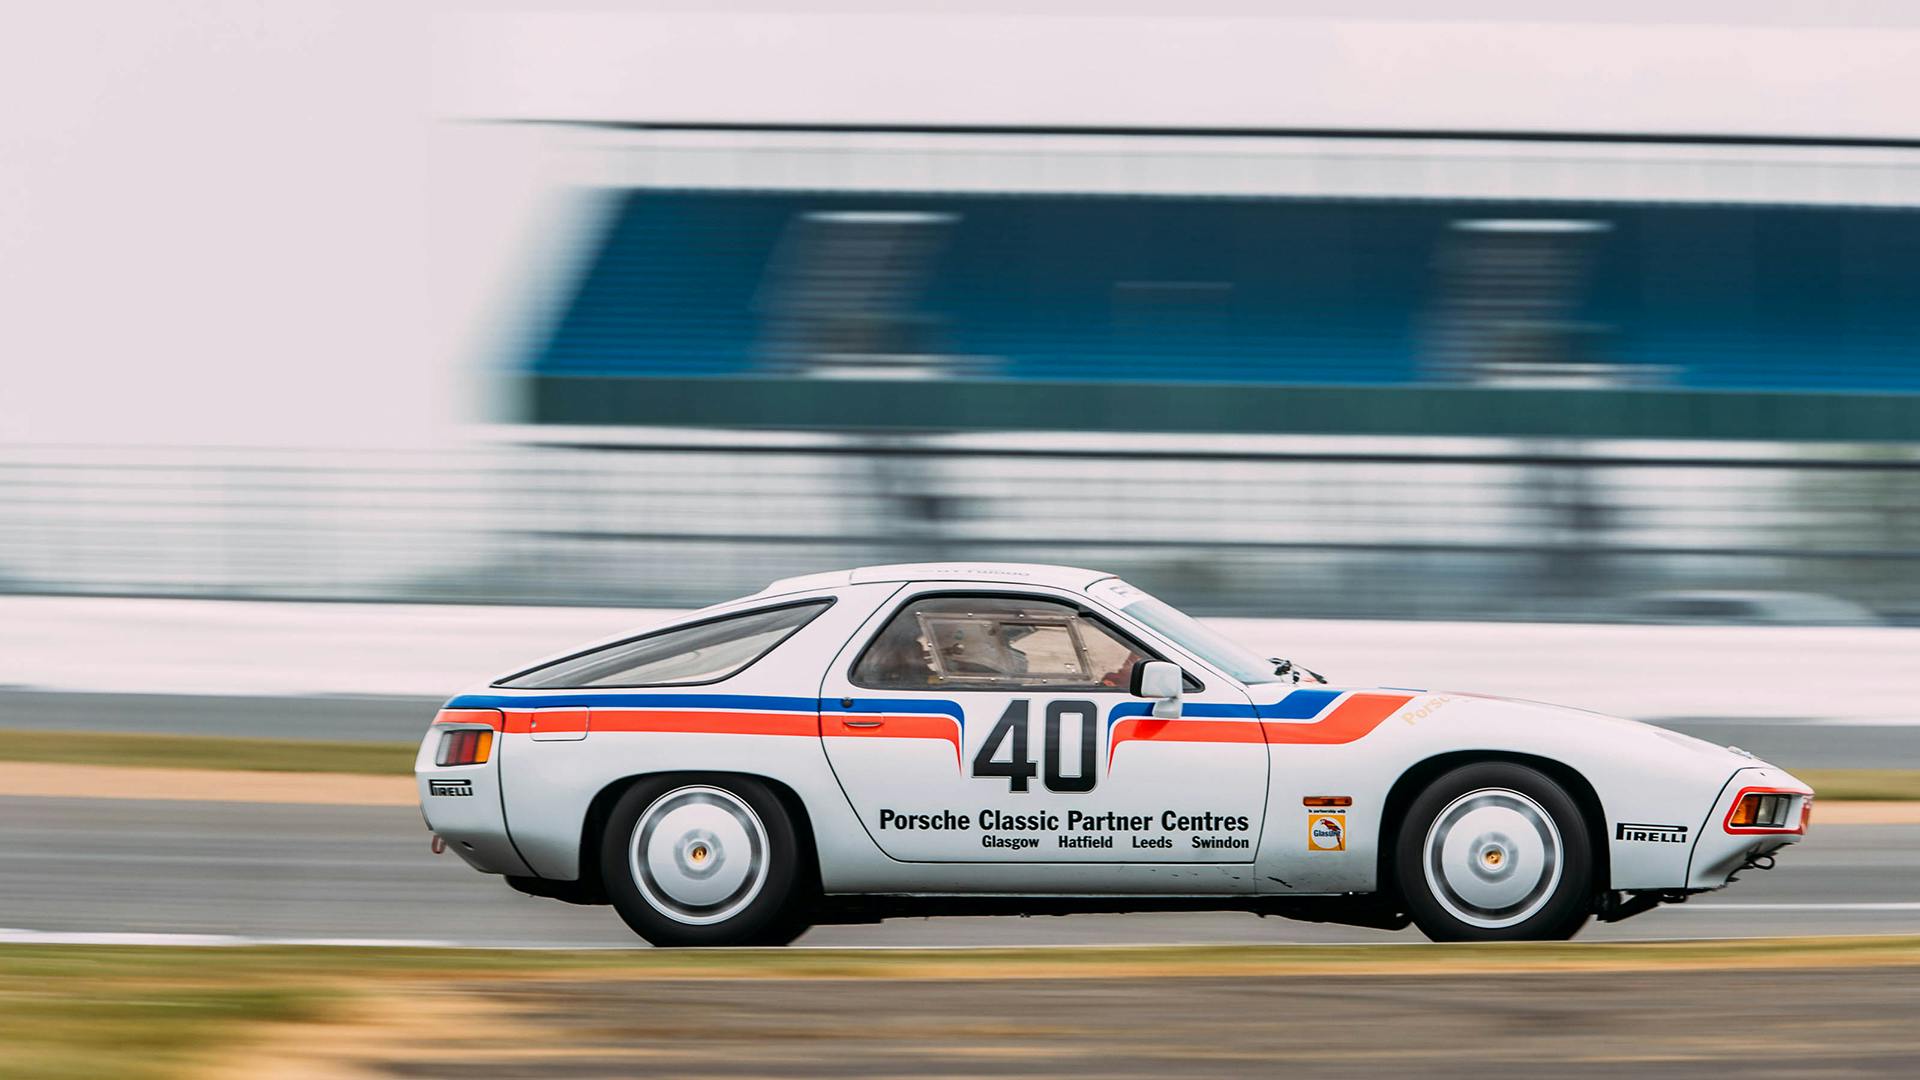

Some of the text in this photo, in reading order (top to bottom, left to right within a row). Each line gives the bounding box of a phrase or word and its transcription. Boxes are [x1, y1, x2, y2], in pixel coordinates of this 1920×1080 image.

[972, 698, 1098, 793] 40
[428, 778, 474, 797] PIRELLI
[879, 809, 1250, 832] Porsche Classic Partner Centres
[981, 834, 1250, 851] Glasgow Hatfield Leeds Swindon
[1616, 822, 1689, 844] PIRELLI
